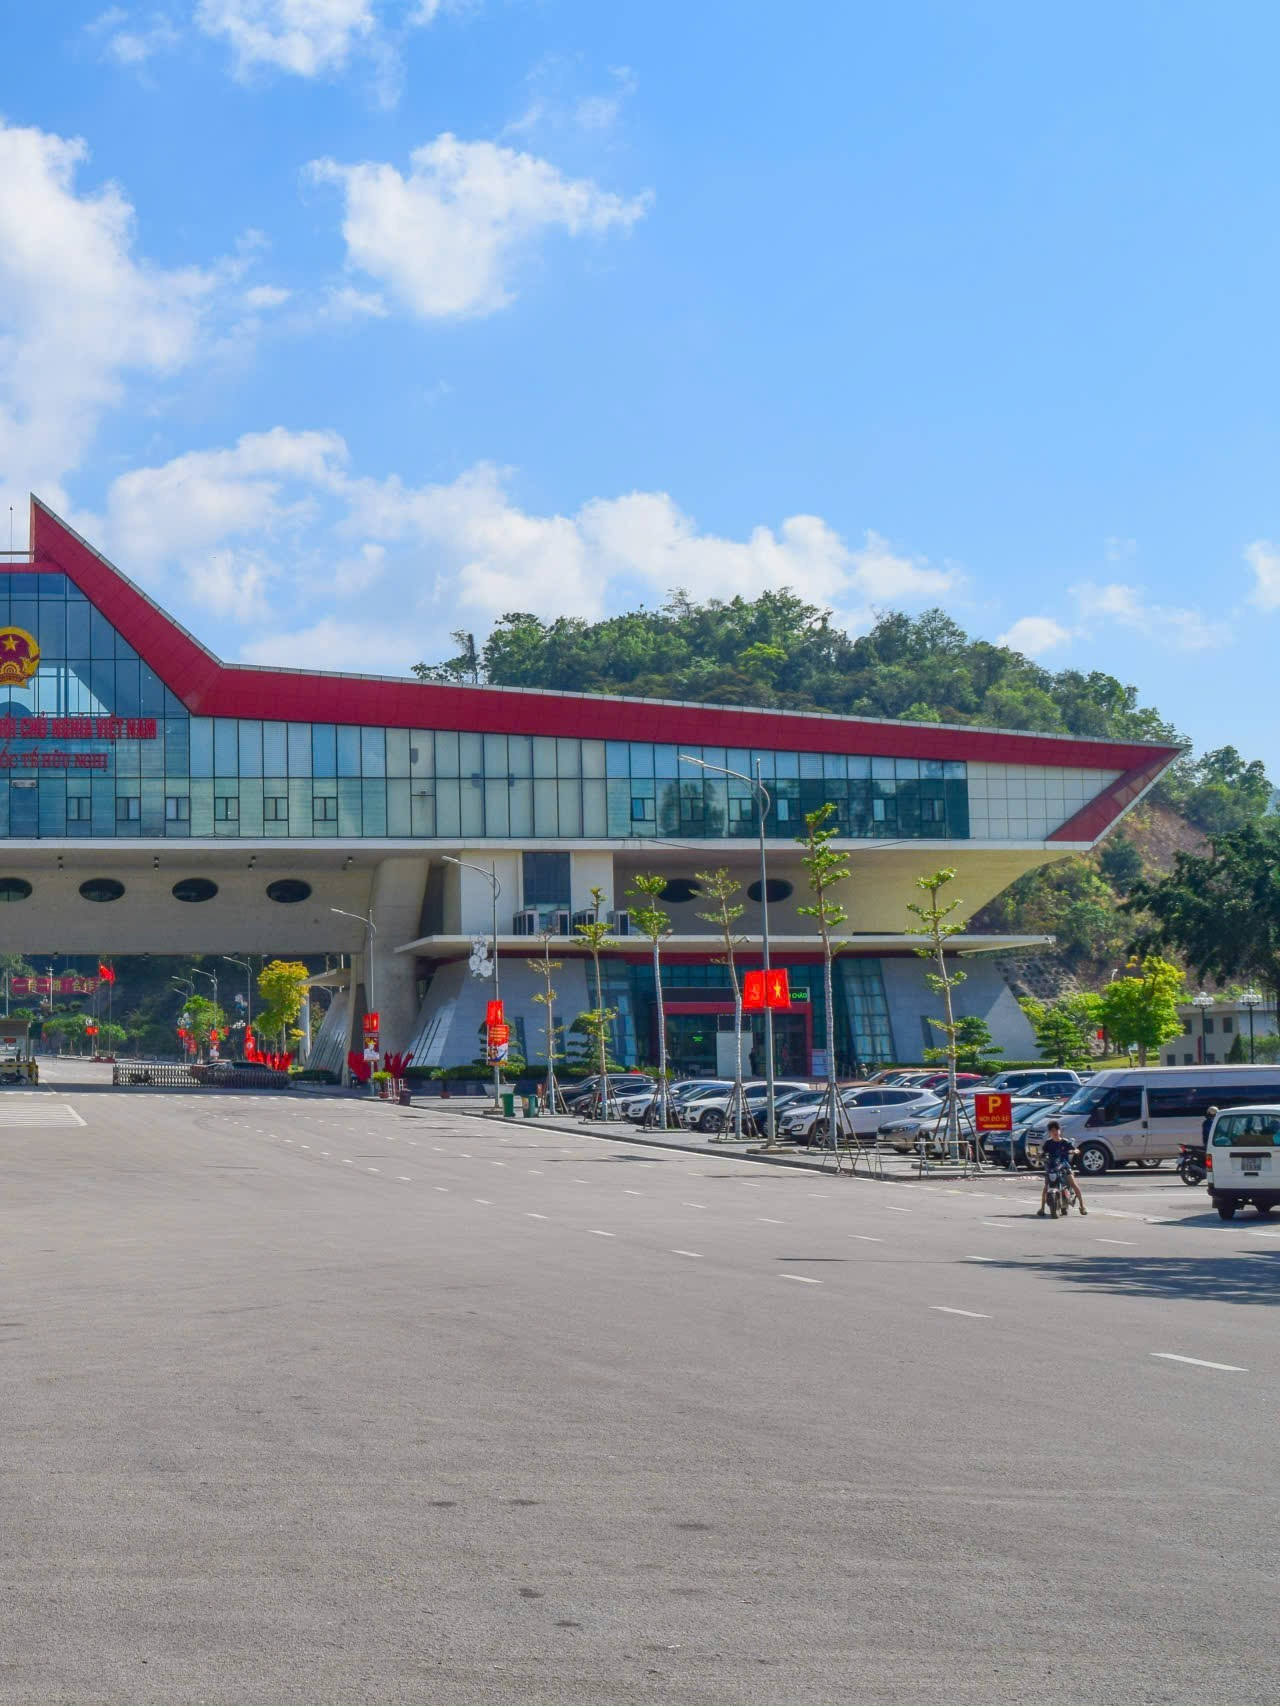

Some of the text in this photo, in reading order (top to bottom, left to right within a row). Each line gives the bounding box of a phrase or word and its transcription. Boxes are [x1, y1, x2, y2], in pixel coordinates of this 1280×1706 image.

[21, 711, 47, 738] CHỦ
[96, 712, 123, 745] VIỆT
[126, 718, 157, 739] NAM
[21, 745, 38, 768] TẾ
[988, 1096, 1002, 1114] P
